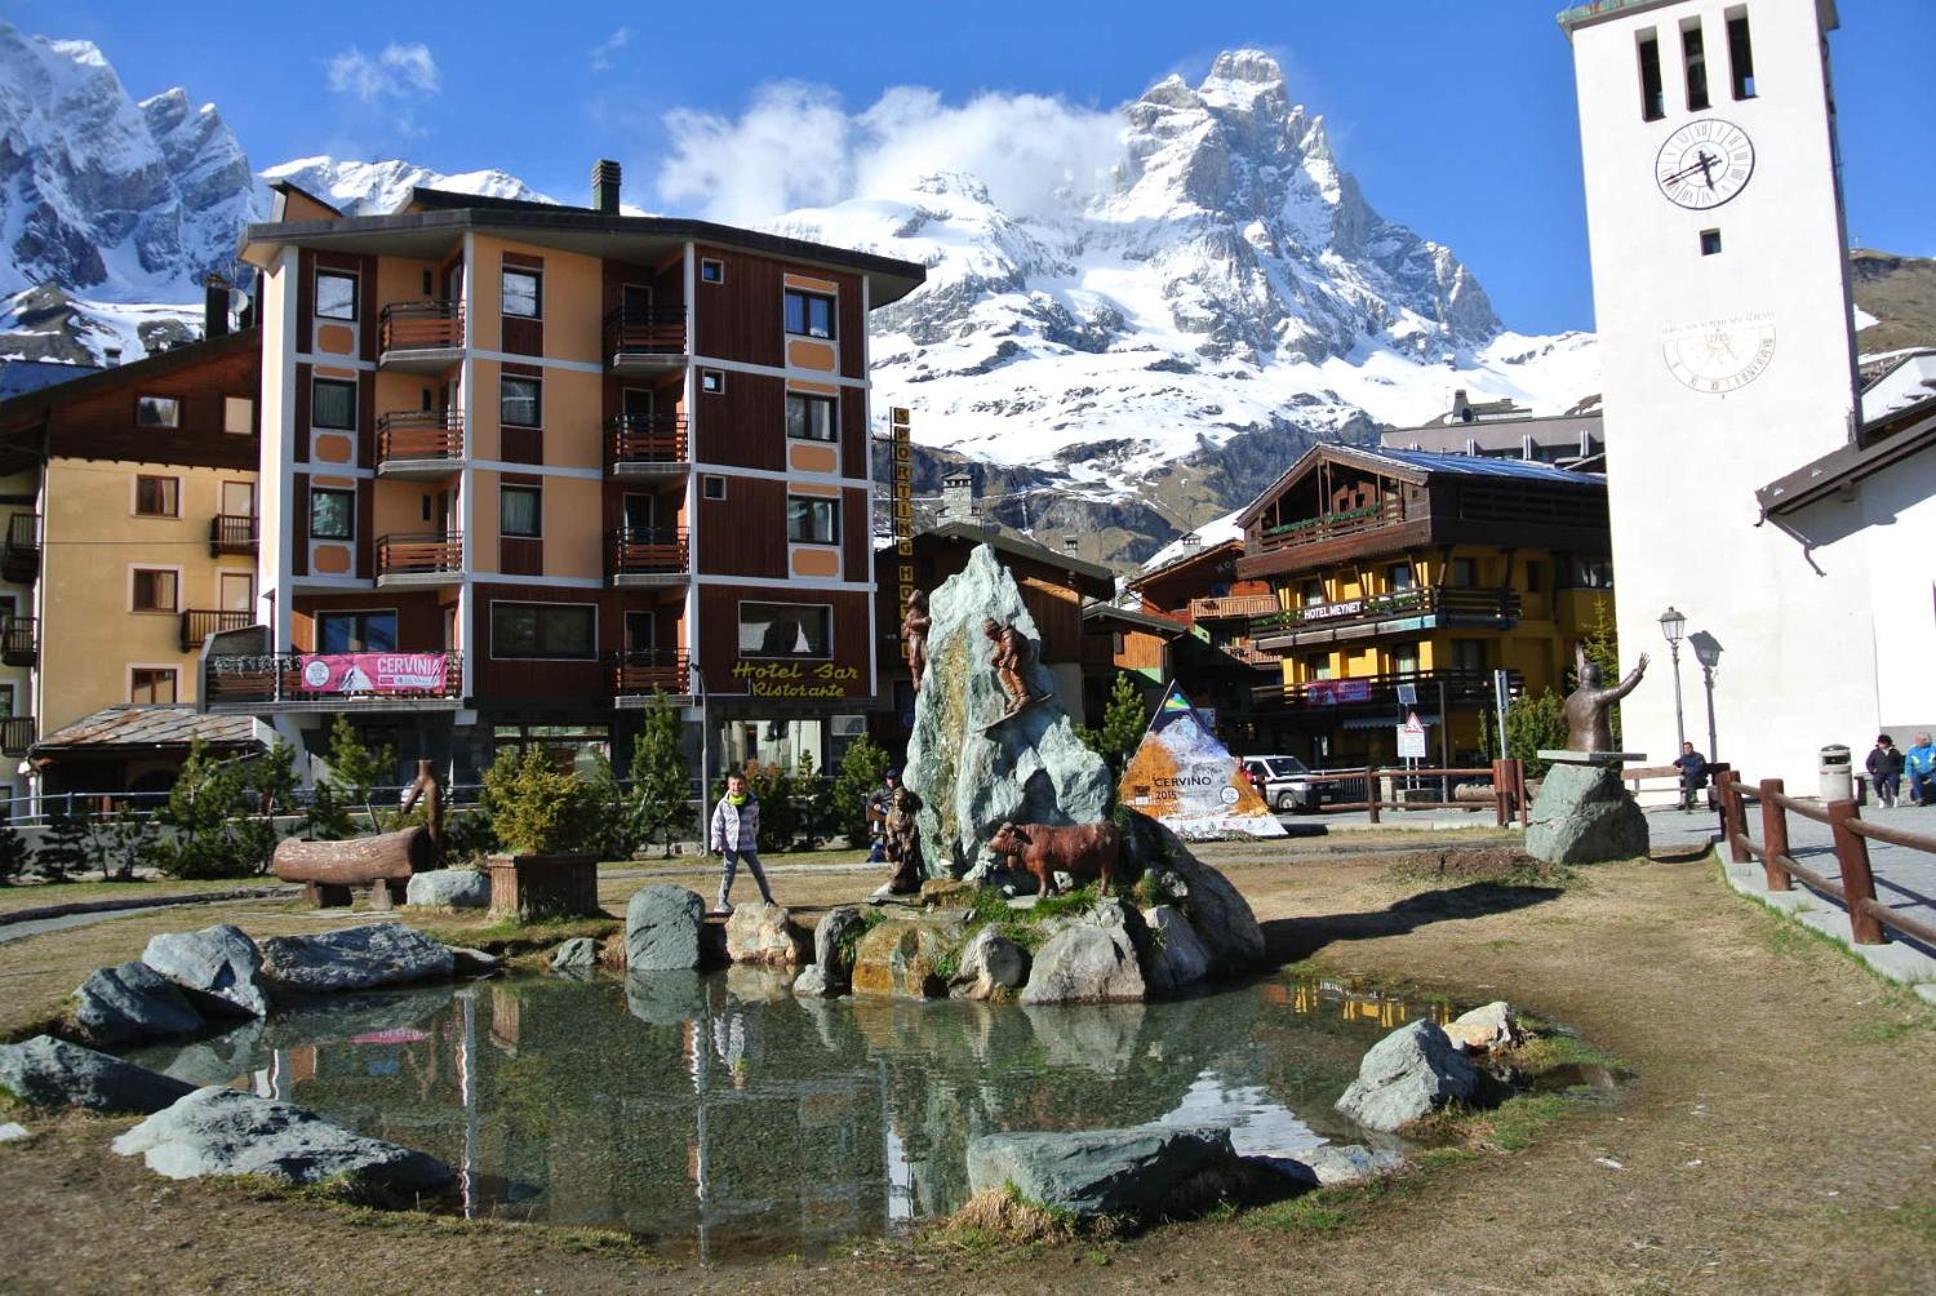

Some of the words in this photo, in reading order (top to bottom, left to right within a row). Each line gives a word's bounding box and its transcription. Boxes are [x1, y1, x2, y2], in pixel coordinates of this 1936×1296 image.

[896, 408, 912, 554] SPORTING
[1304, 606, 1329, 620] HOTEL
[1329, 600, 1362, 617] MEYNET
[731, 661, 803, 679] Hotel
[814, 663, 860, 680] Bar
[752, 681, 846, 697] Ristorante
[1153, 775, 1212, 787] CERVINO
[1156, 790, 1177, 800] 2015
